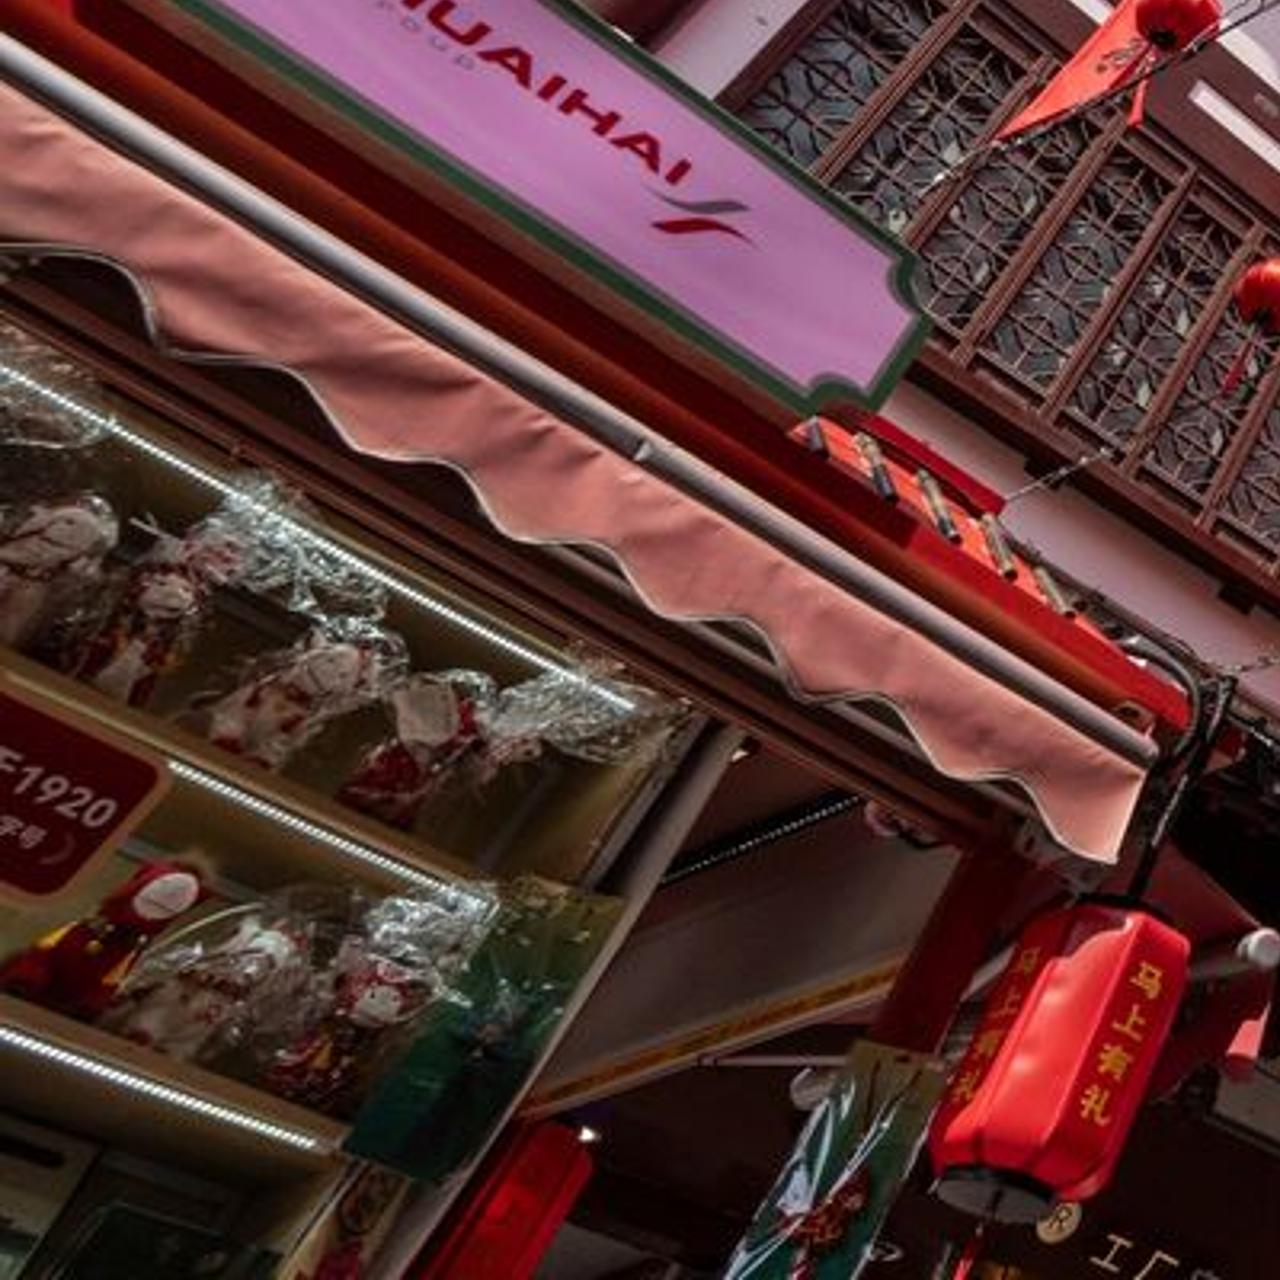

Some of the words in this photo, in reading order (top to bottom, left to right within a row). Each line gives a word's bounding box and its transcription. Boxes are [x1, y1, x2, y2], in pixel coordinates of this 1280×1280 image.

[1079, 960, 1163, 1127] 马上有礼
[1089, 1233, 1222, 1280] 工厂
